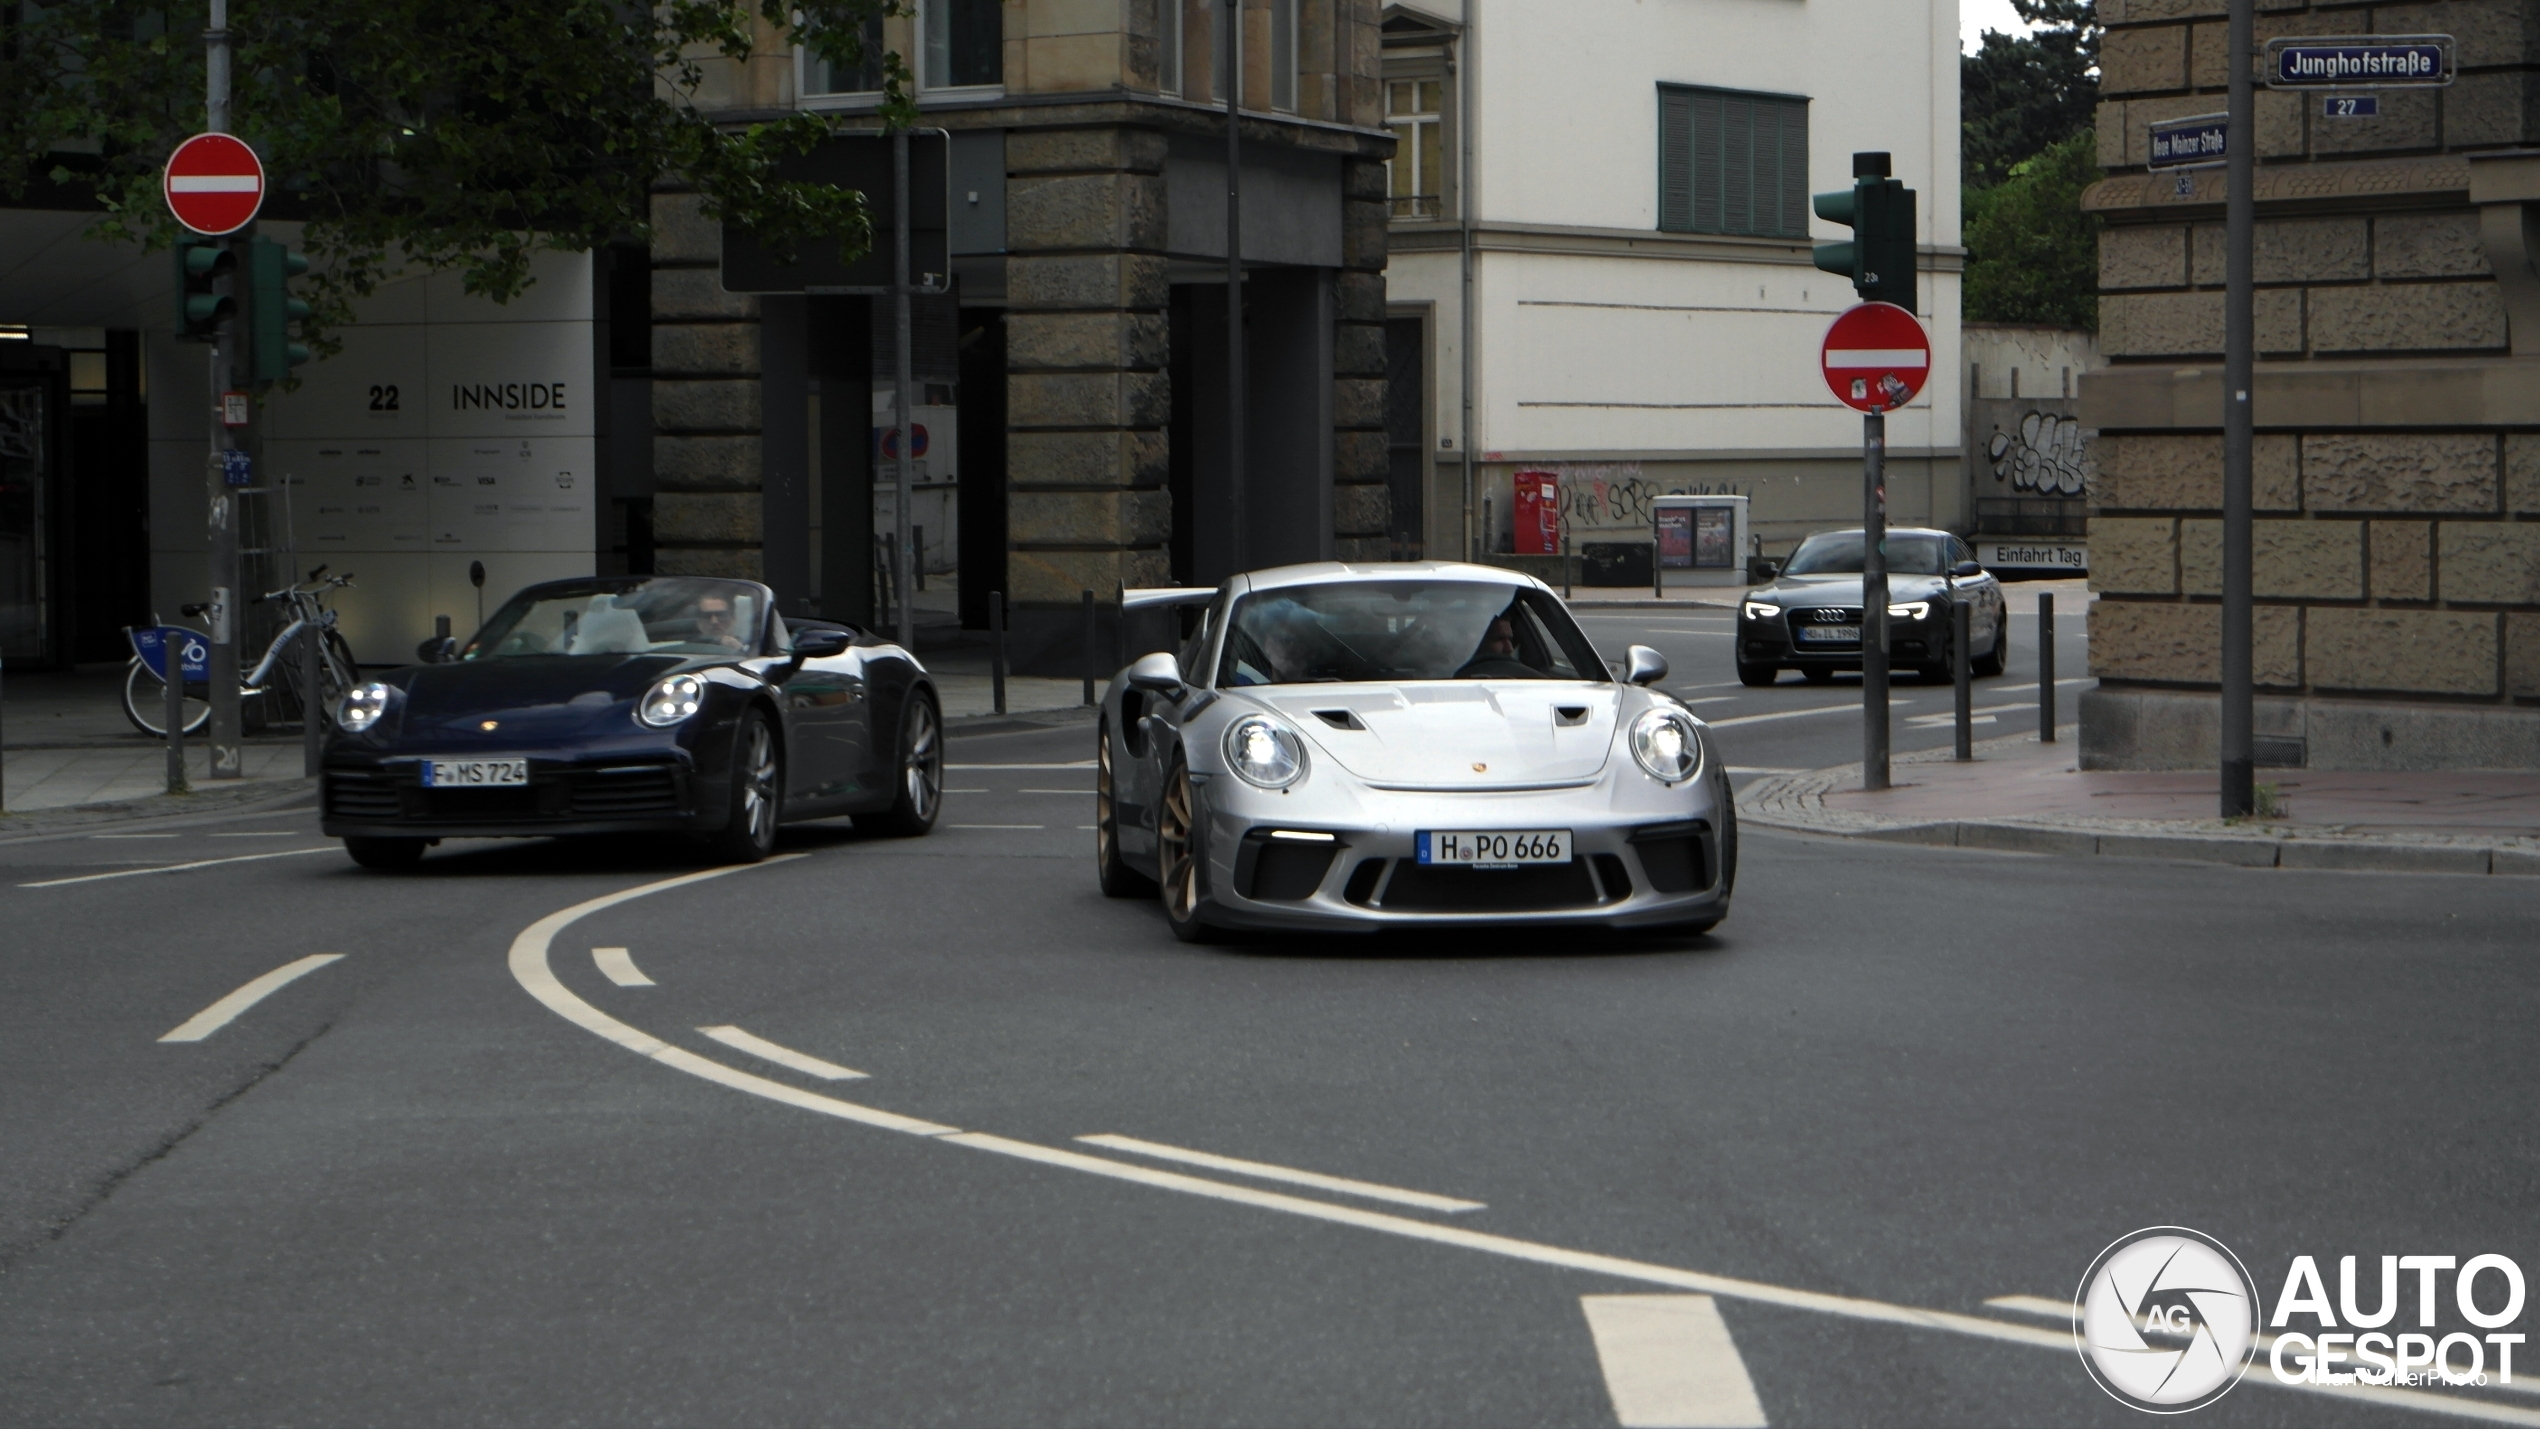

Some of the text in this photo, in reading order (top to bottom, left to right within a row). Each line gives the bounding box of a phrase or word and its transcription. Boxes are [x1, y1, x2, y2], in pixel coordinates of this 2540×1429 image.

[2290, 50, 2431, 78] Junghofstraße
[2337, 99, 2357, 115] 27
[2153, 128, 2224, 157] Neue Mainzer Straße
[369, 384, 399, 411] 22
[453, 382, 566, 410] INNSIDE
[1996, 546, 2082, 567] Einfahrt Tag
[433, 763, 525, 782] F MS 724
[1441, 834, 1561, 860] H PO 666
